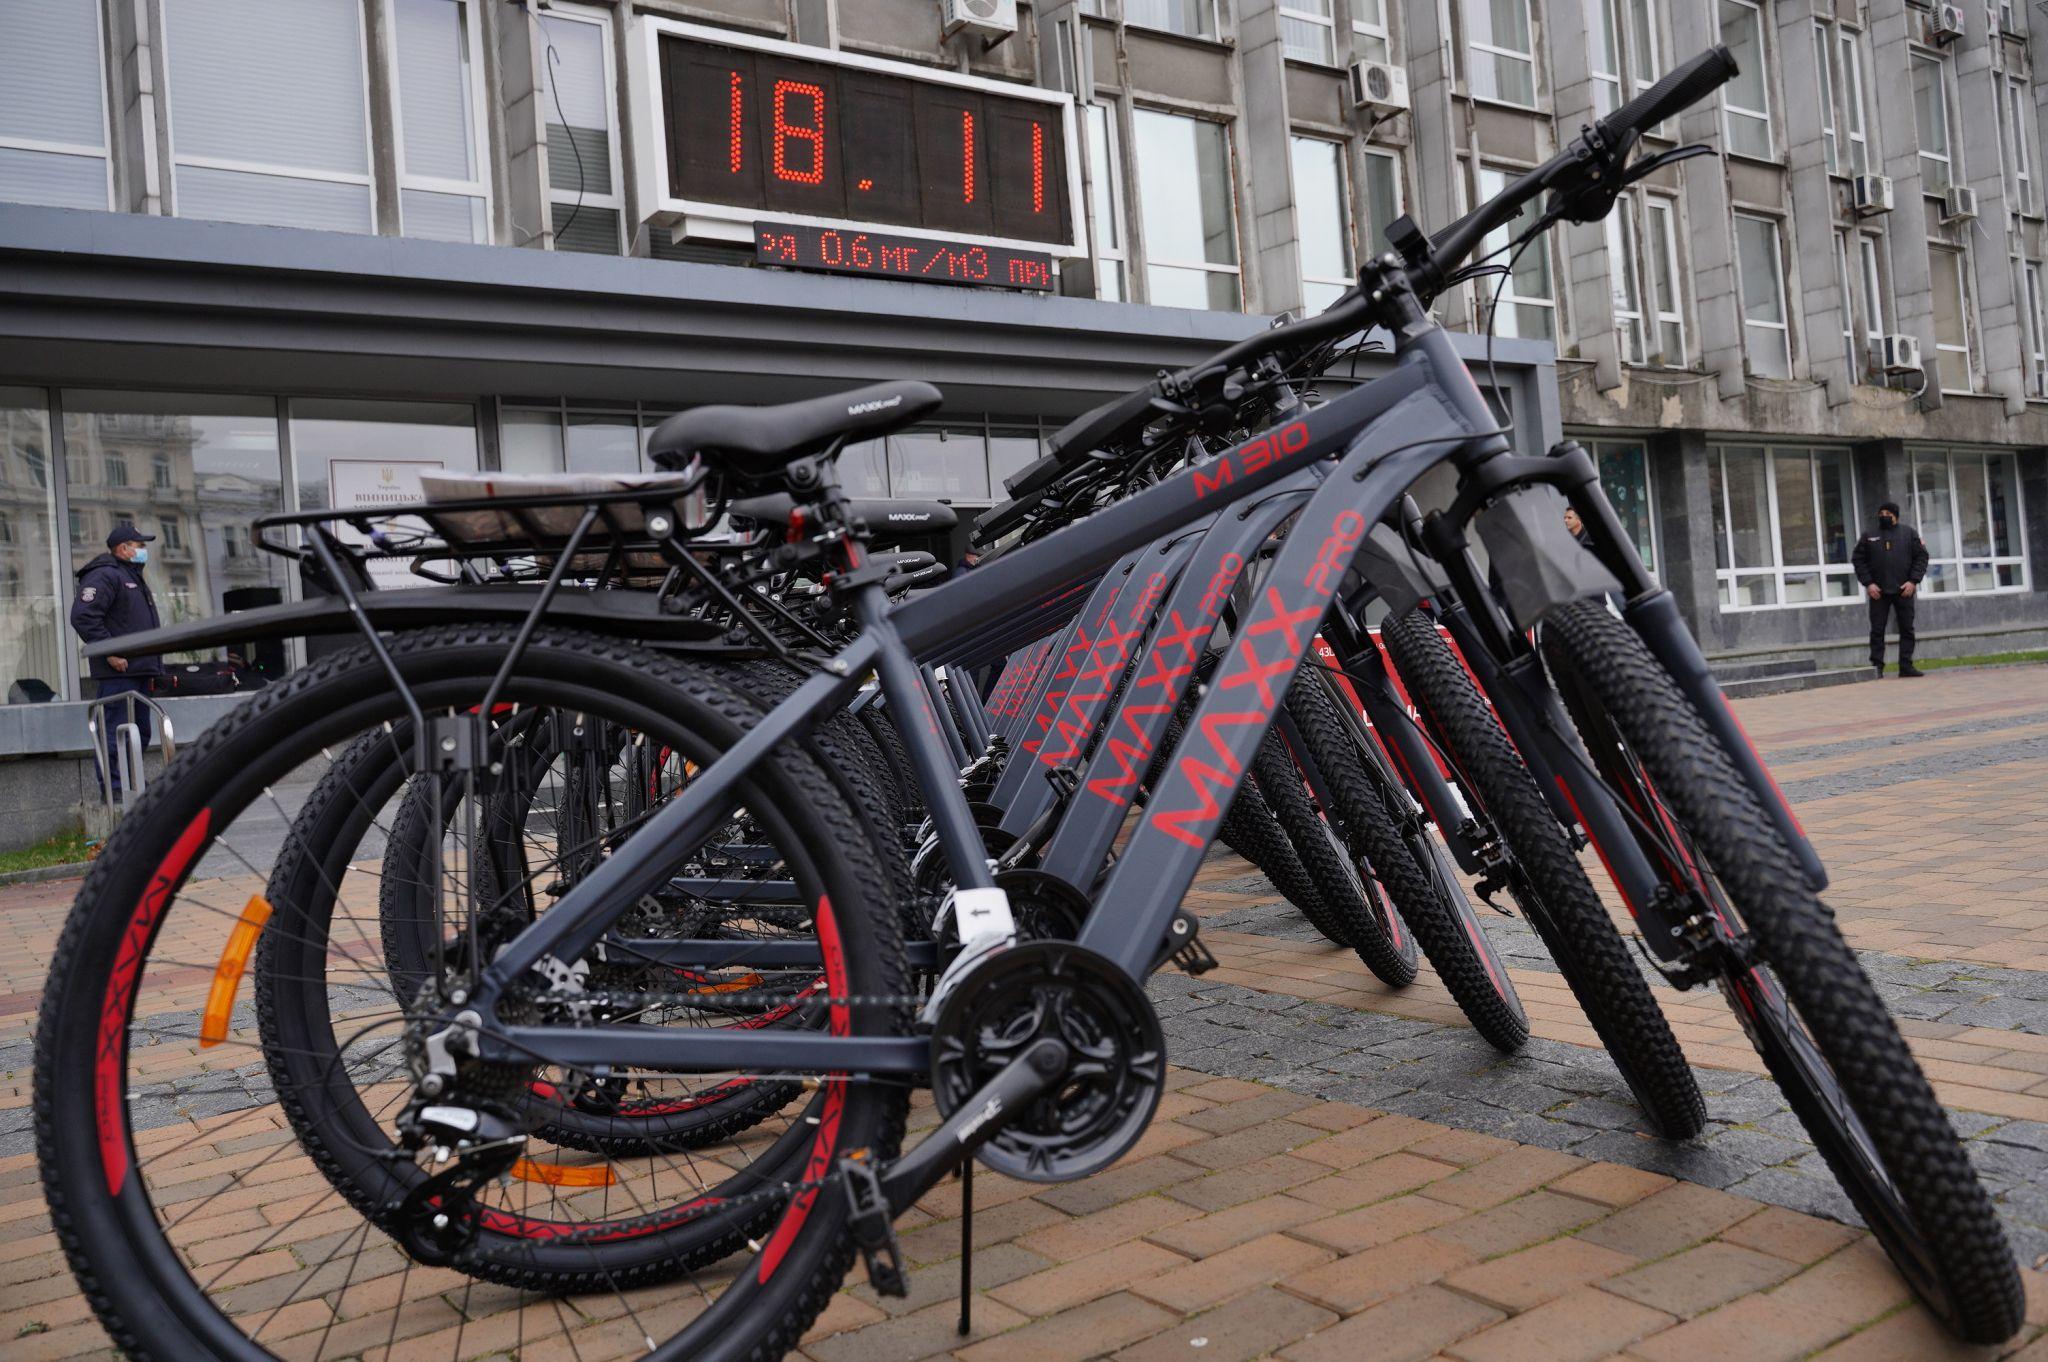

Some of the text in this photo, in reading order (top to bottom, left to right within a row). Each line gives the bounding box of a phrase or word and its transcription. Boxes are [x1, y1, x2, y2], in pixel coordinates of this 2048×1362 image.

[1192, 421, 1310, 499] M 310
[1039, 618, 1141, 767] MAXX
[1130, 571, 1168, 625] PRO
[1087, 552, 1244, 806] MAXX PRO
[1151, 508, 1366, 849] MAXX PRO
